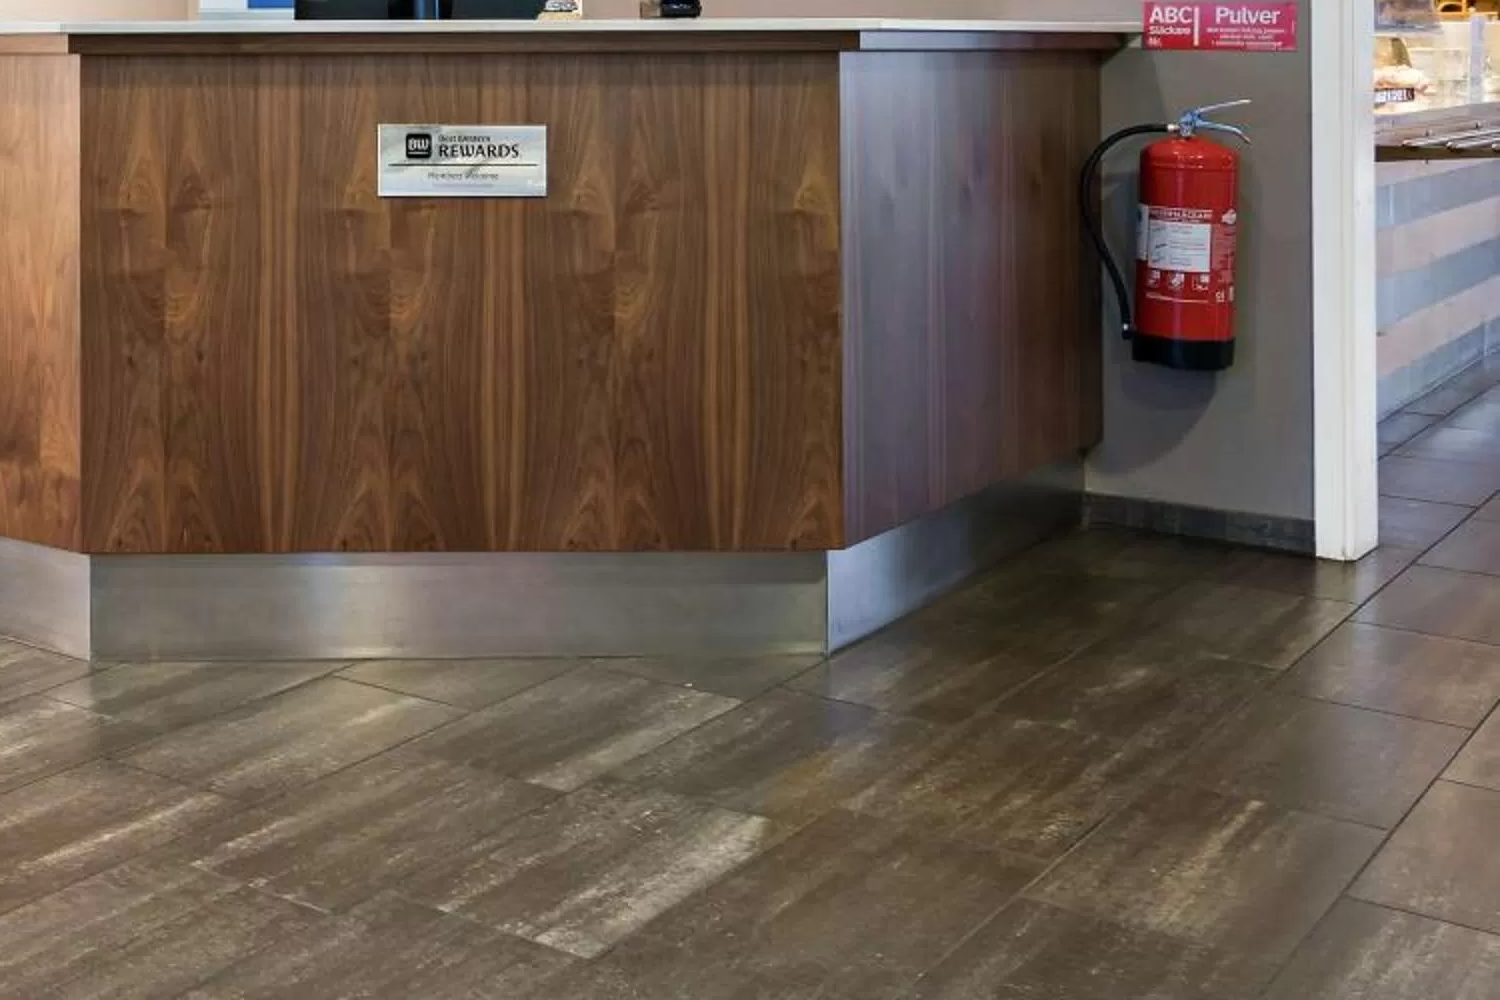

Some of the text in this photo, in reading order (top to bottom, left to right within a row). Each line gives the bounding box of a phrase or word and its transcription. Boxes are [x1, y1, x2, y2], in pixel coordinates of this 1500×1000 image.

[1149, 5, 1281, 25] ABC Pulver
[438, 143, 520, 159] REWARDS
